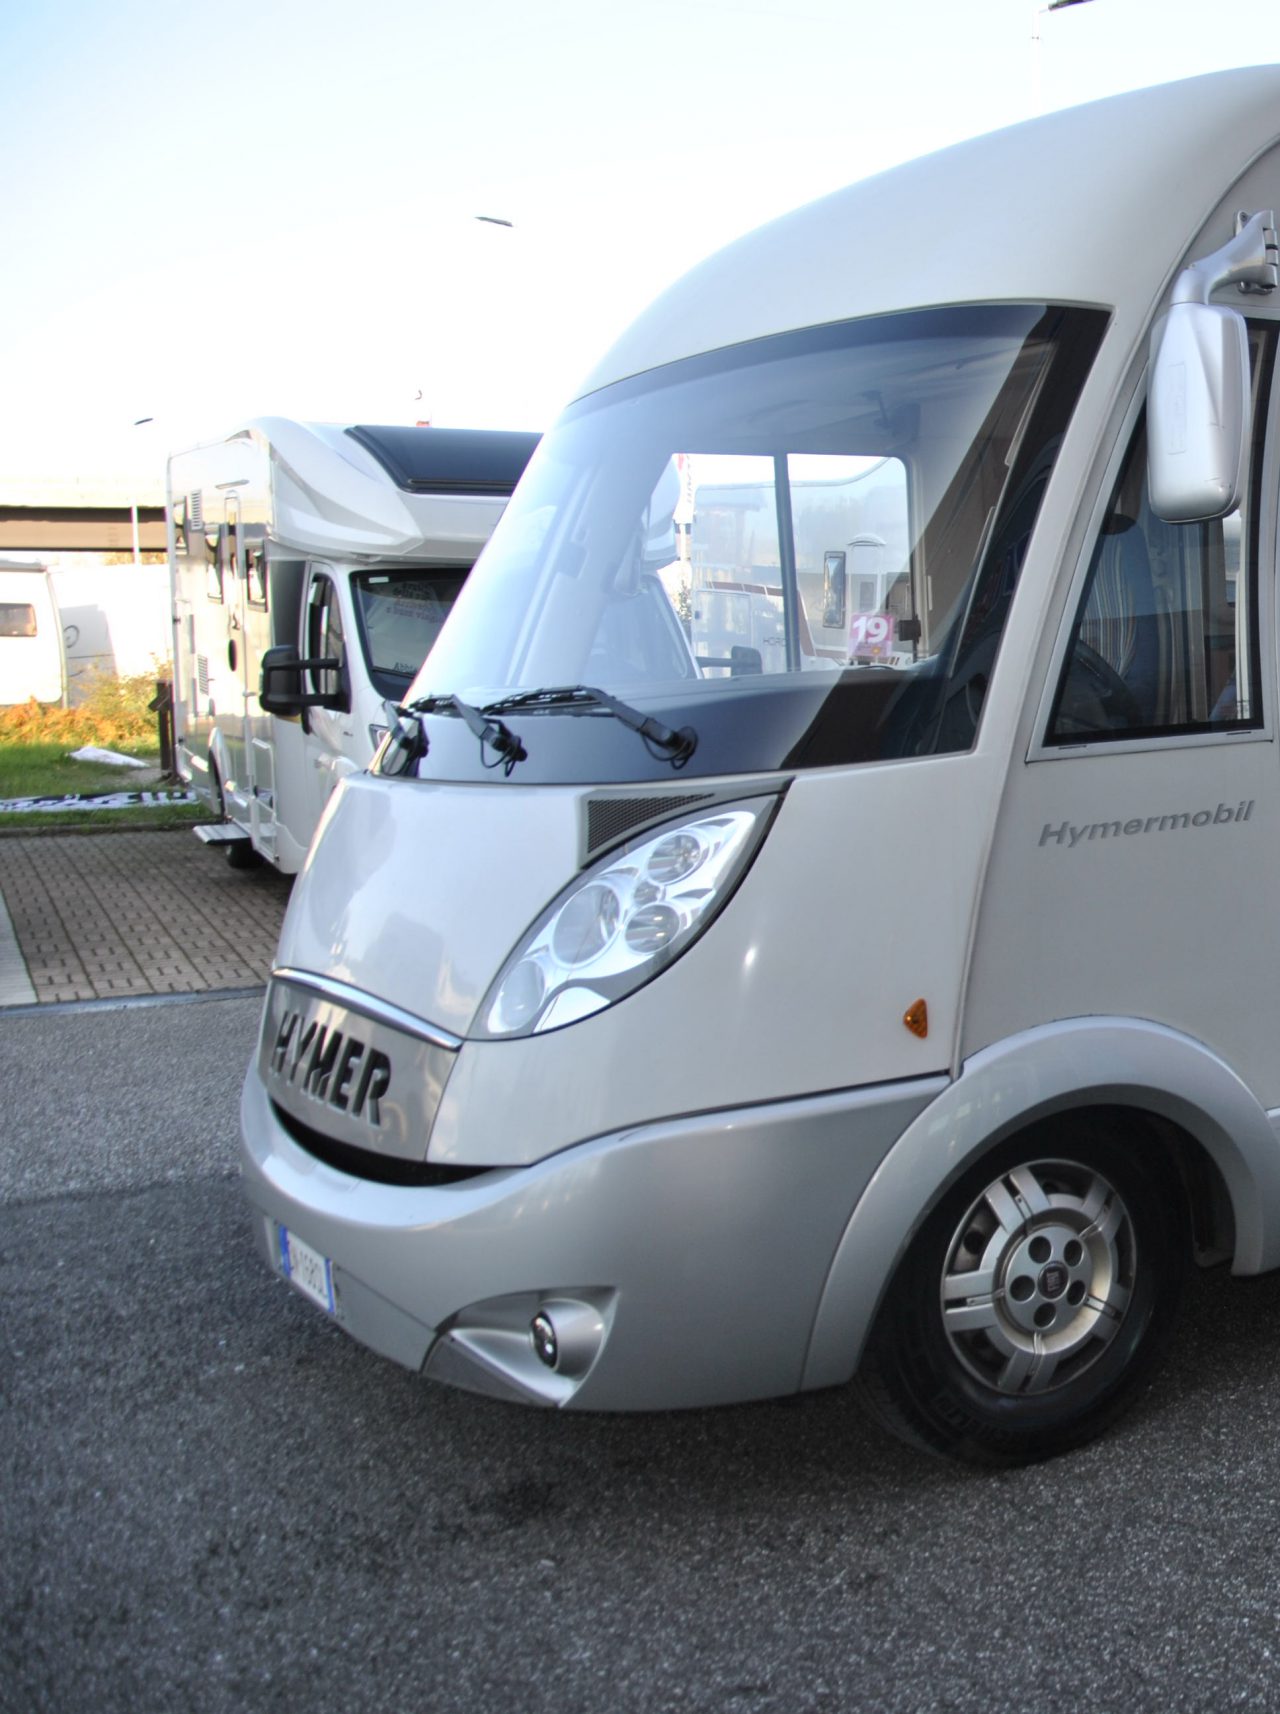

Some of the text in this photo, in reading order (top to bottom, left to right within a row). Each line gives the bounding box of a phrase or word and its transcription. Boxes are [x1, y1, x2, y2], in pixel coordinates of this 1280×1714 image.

[853, 615, 888, 644] 19
[1038, 800, 1254, 848] Hymermobil
[271, 1010, 391, 1128] HYMER
